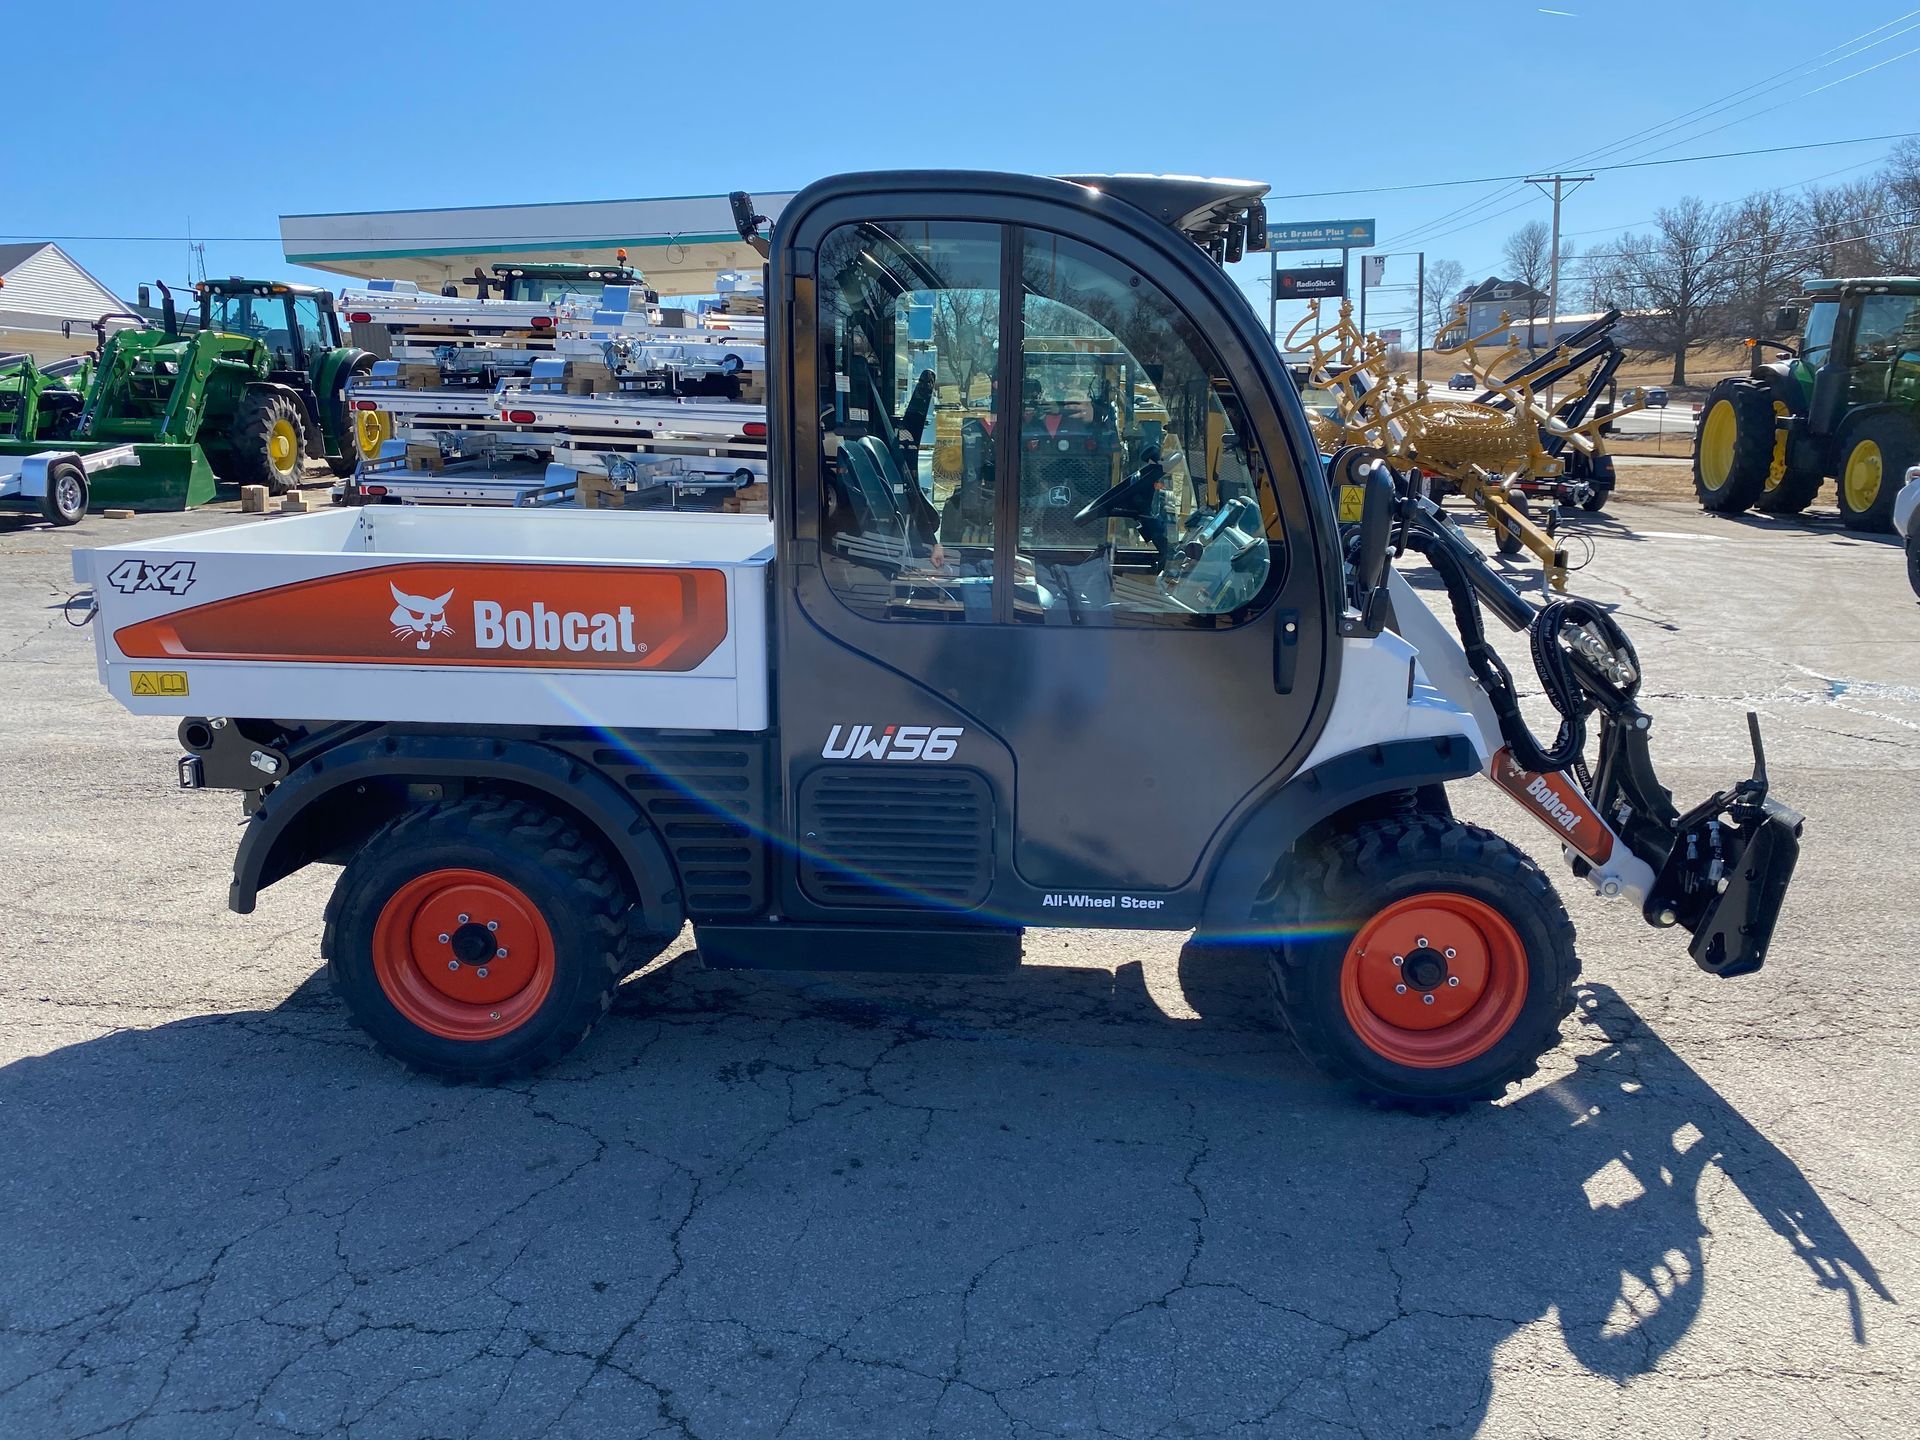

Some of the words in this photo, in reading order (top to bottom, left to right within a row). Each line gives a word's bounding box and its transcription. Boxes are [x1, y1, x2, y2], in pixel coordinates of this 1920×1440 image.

[1266, 231, 1287, 239] Best
[1290, 229, 1322, 238] Brands
[1325, 228, 1344, 236] Plus
[1296, 279, 1336, 288] RadioShack
[107, 560, 196, 595] 4x4
[473, 600, 636, 653] Bobcat
[1526, 775, 1582, 832] Bobcat
[1042, 894, 1116, 908] All-Wheel
[1120, 895, 1164, 909] Steer
